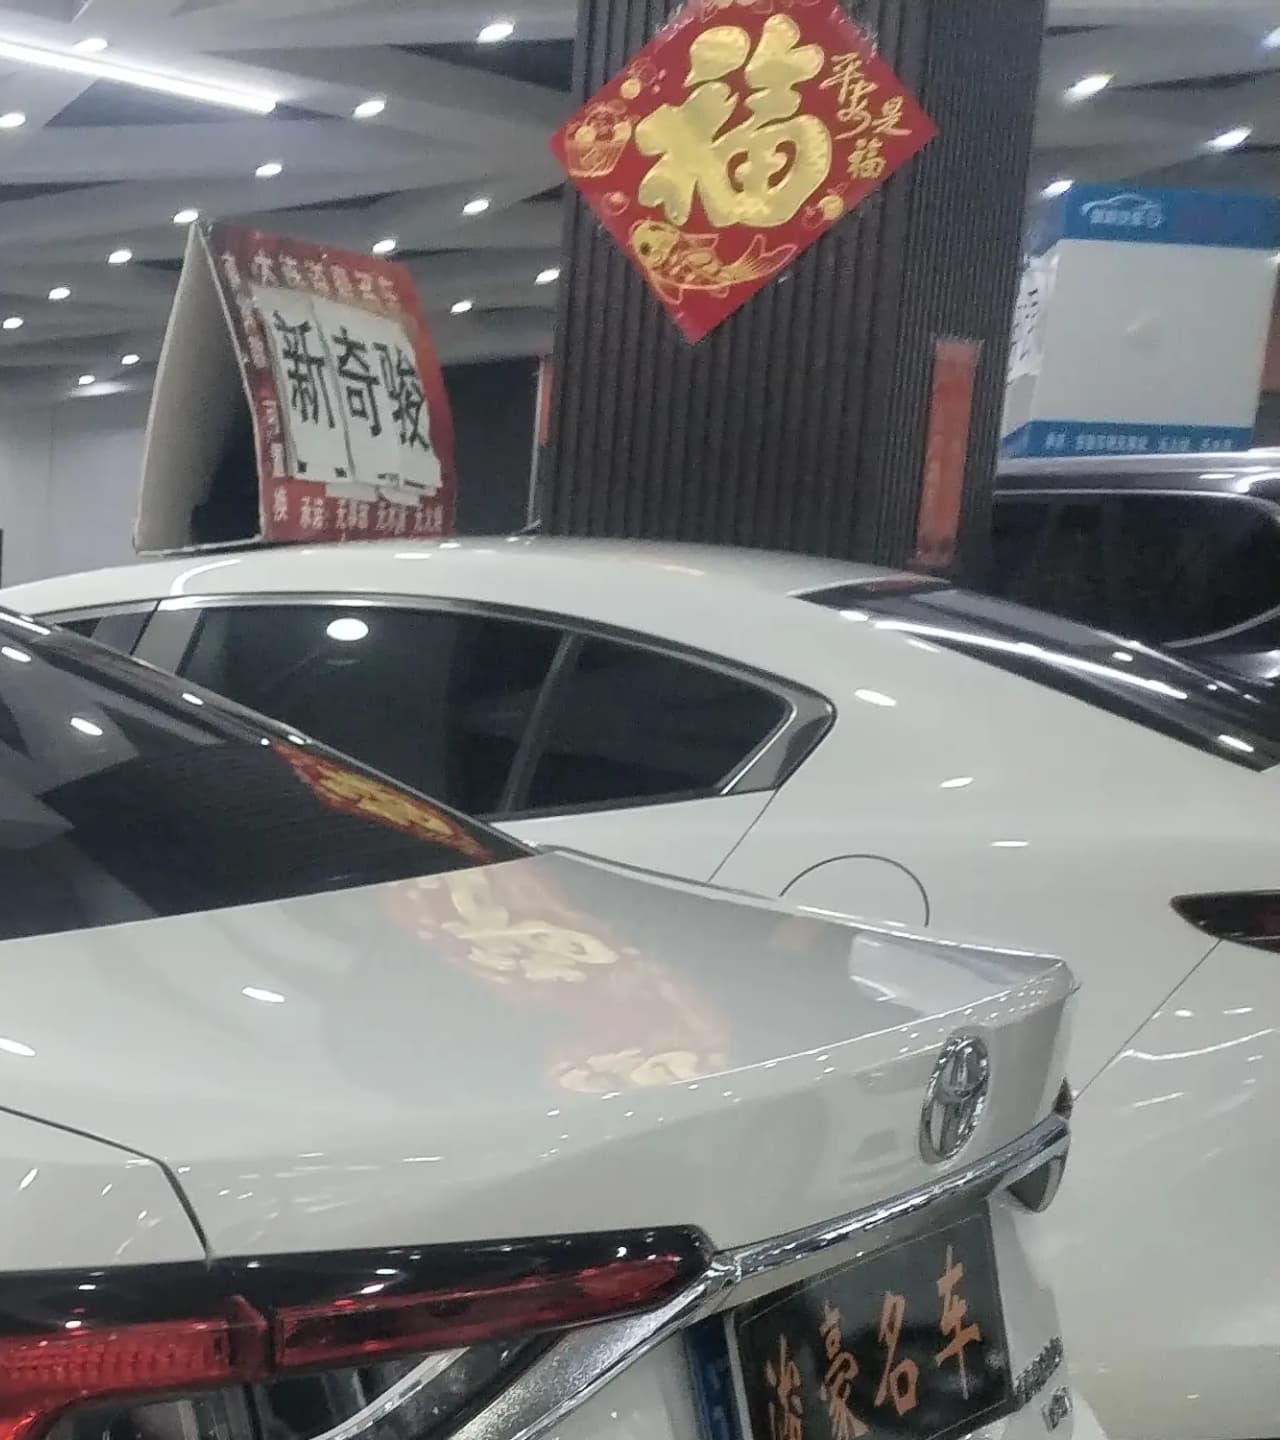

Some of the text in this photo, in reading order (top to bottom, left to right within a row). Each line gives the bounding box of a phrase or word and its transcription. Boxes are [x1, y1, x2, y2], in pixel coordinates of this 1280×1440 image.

[635, 13, 832, 227] 福
[272, 309, 430, 451] 新奇骏
